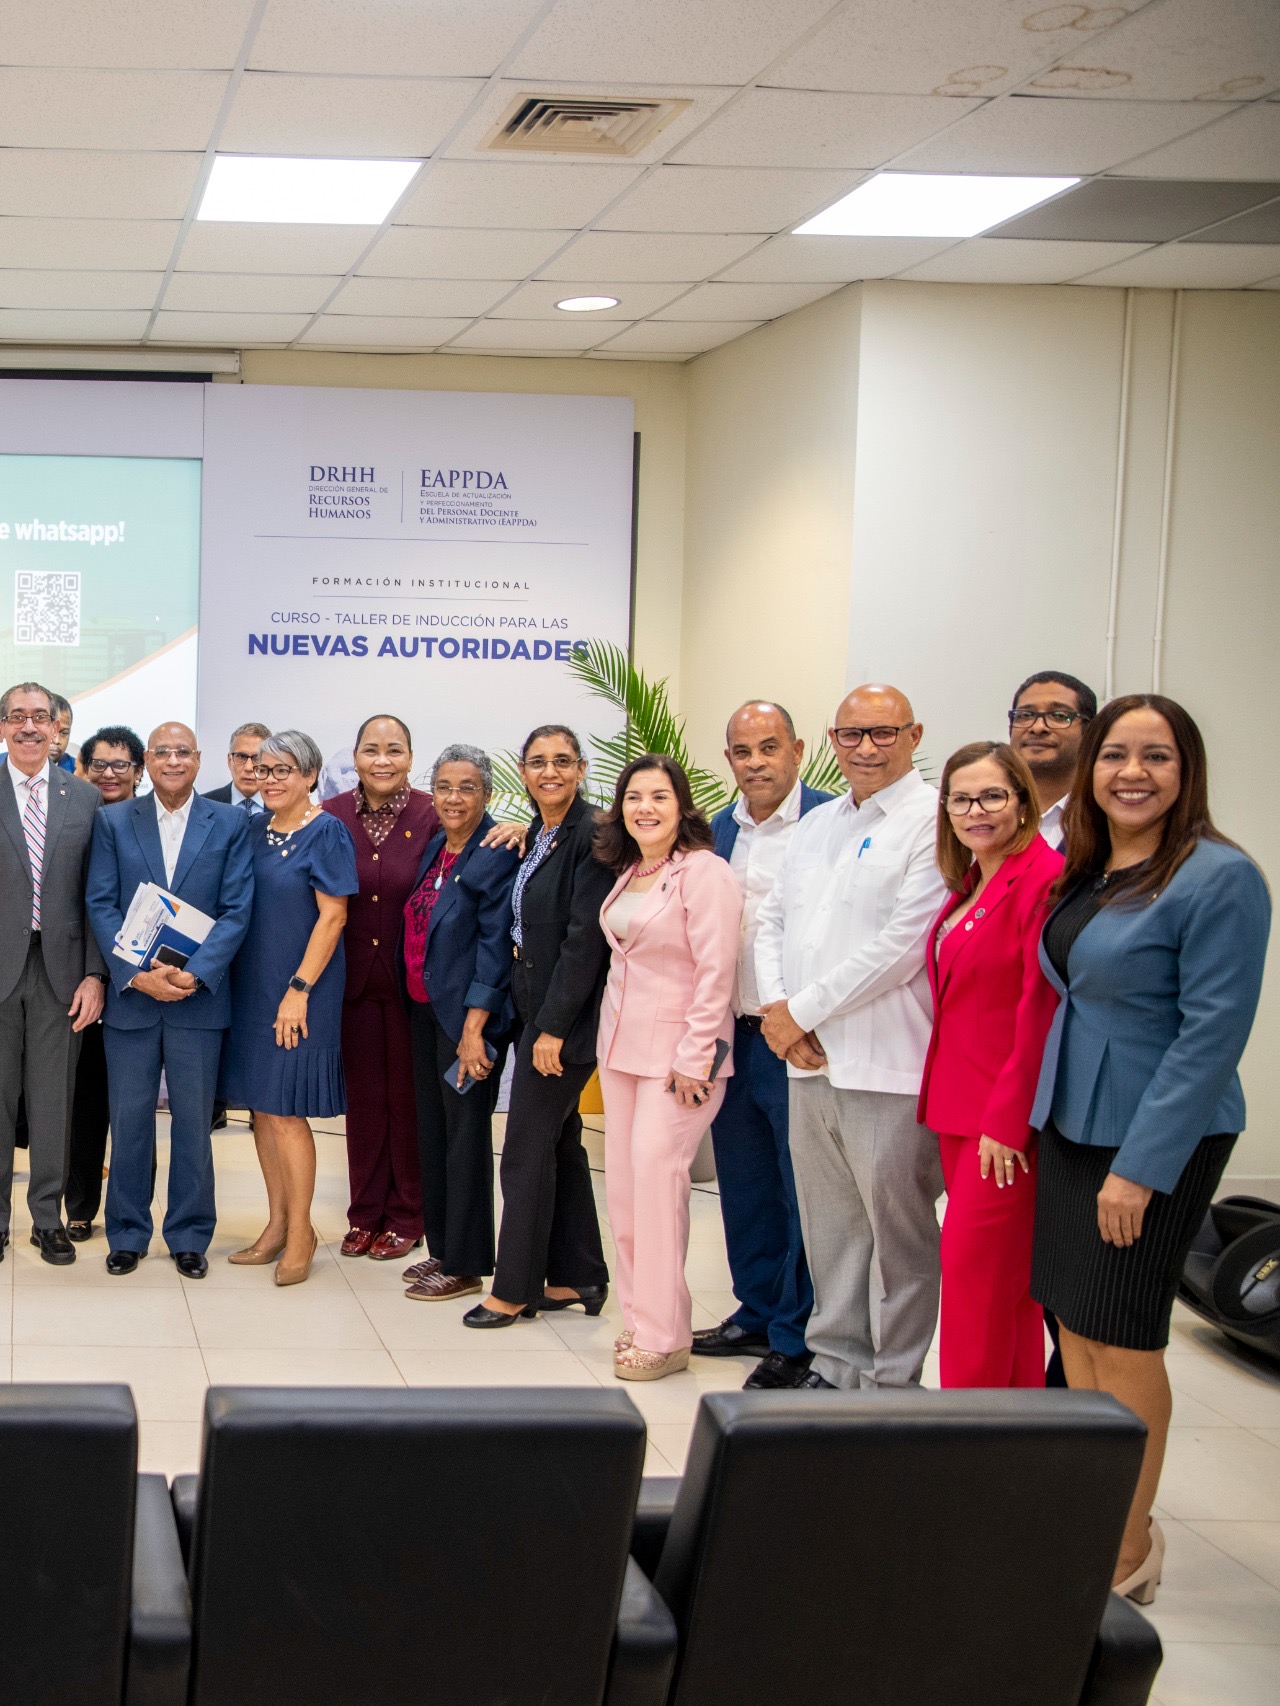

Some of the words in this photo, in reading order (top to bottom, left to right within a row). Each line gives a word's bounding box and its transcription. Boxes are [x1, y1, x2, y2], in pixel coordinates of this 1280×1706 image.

[309, 465, 375, 483] DRHH
[420, 469, 508, 490] EAPPDA
[309, 494, 370, 506] RECURSOS
[309, 507, 371, 519] HUMANOS
[14, 518, 125, 546] whatsapp!
[312, 576, 402, 587] FORMACIÓN
[411, 579, 530, 590] INSTITUCIONAL
[271, 612, 321, 624] CURSO
[335, 613, 388, 625] TALLER
[393, 614, 411, 626] DE
[416, 613, 495, 628] INDUCCIÓN
[500, 616, 537, 629] PARA
[542, 617, 568, 629] LAS
[248, 633, 369, 657] NUEVAS
[377, 636, 589, 662] AUTORIDADES
